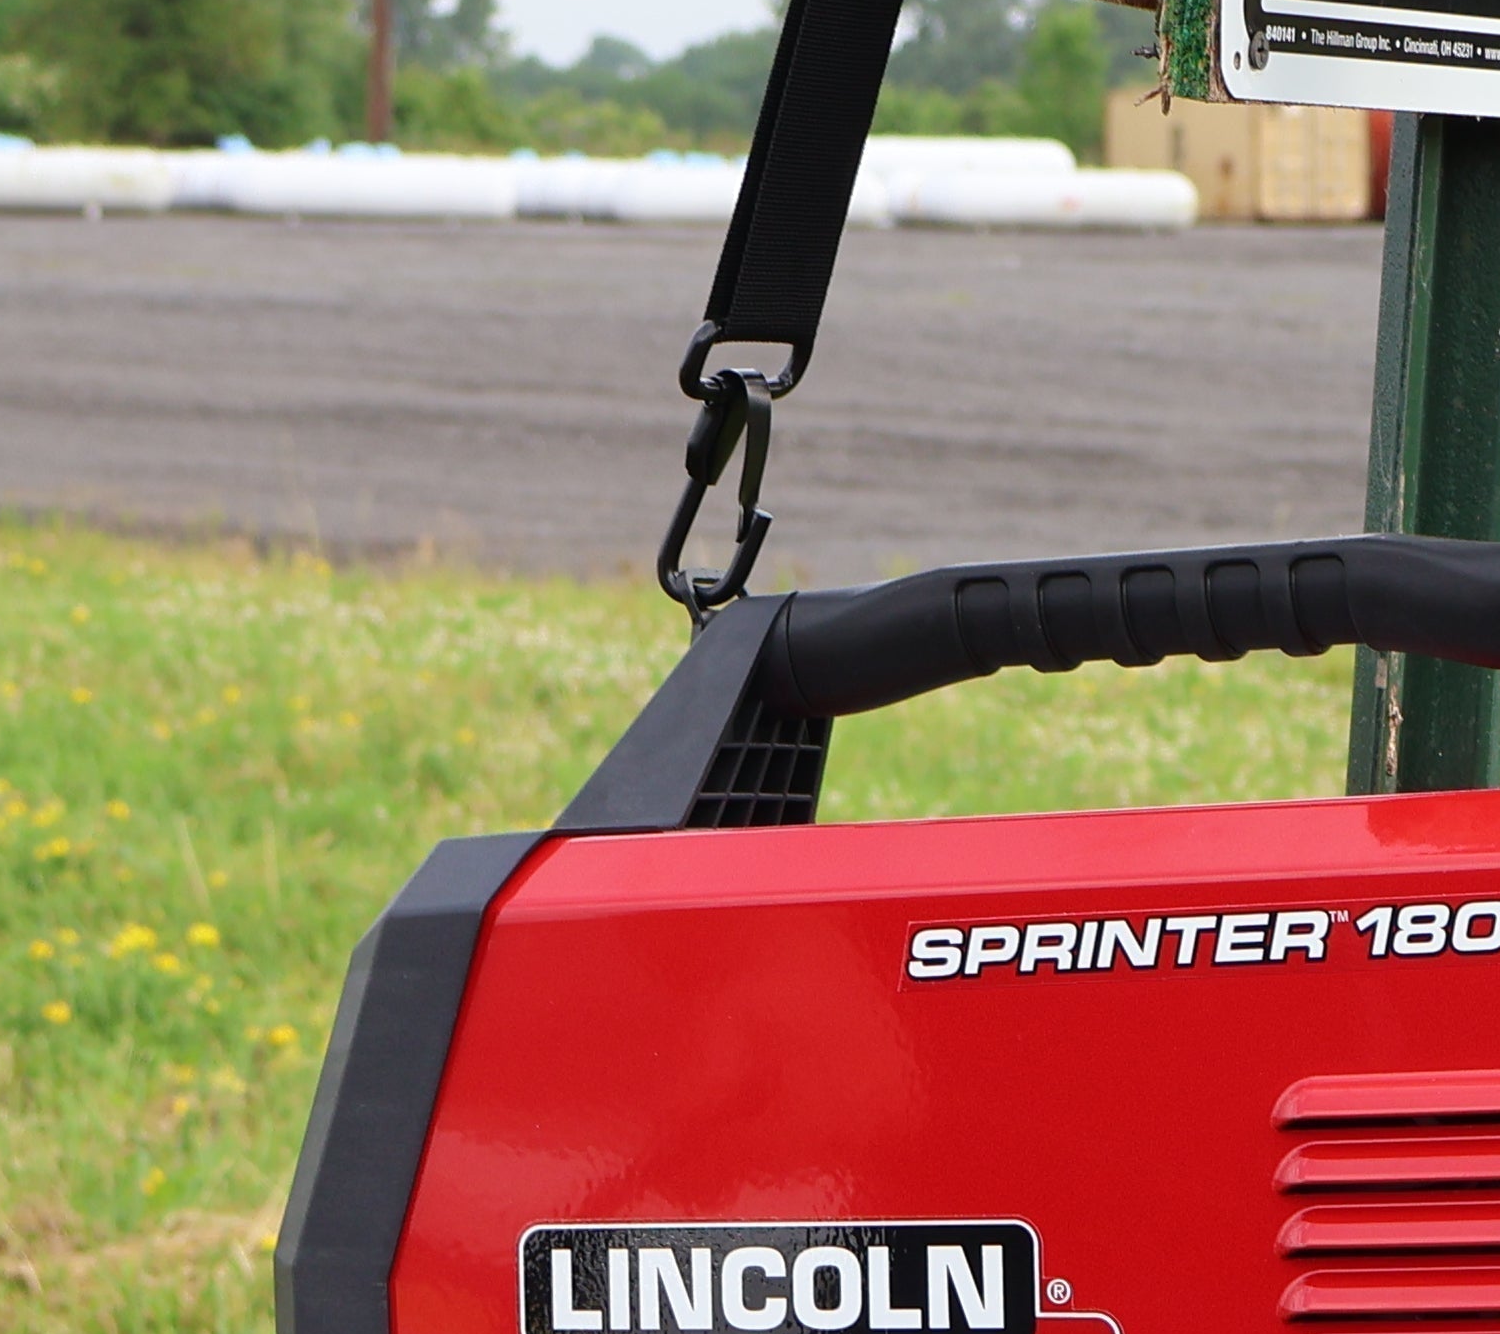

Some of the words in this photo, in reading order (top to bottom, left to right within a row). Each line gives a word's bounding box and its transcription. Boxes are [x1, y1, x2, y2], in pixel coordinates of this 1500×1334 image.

[1265, 24, 1296, 43] 840141
[1311, 28, 1324, 46] The
[1326, 29, 1355, 48] Hillman
[1355, 32, 1377, 53] Group
[1379, 35, 1392, 51] Inc.
[1403, 36, 1440, 57] Cincinnati,
[1441, 40, 1452, 57] OH
[1452, 41, 1474, 59] 45231
[551, 1245, 1005, 1331] LINCOLN
